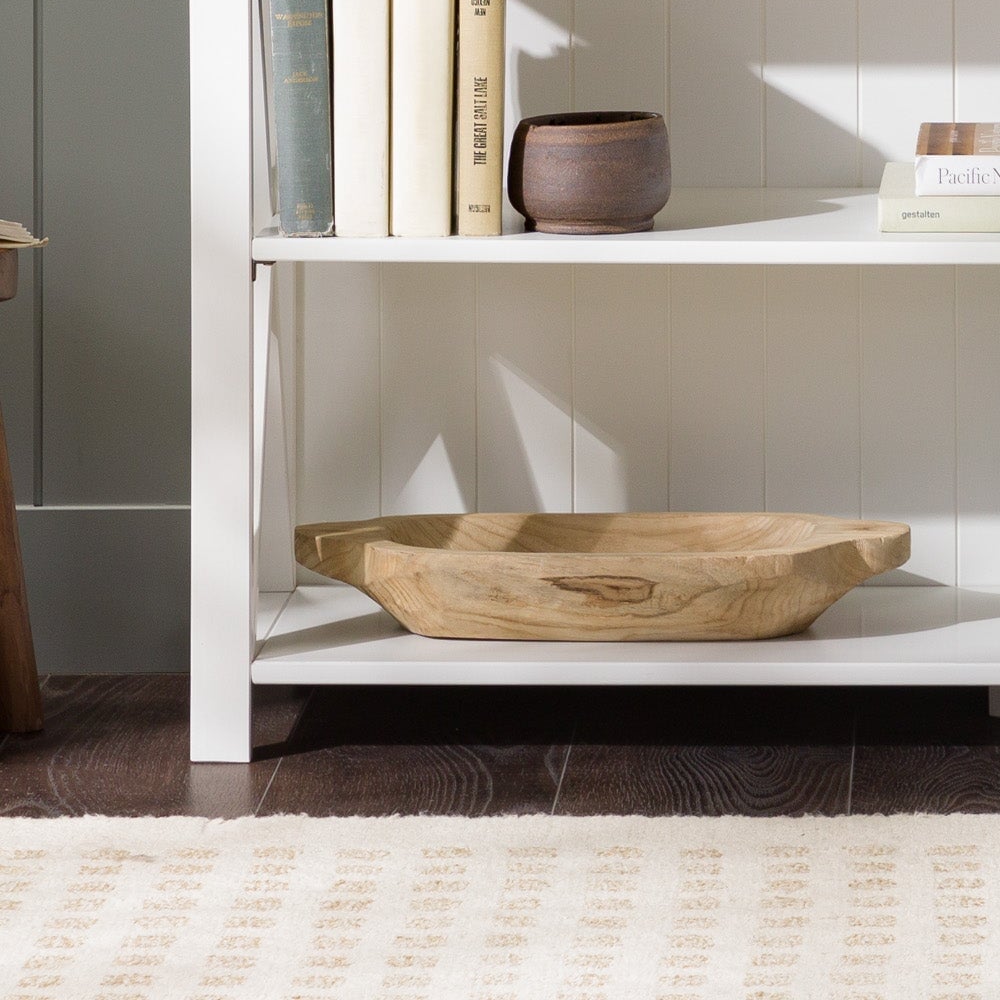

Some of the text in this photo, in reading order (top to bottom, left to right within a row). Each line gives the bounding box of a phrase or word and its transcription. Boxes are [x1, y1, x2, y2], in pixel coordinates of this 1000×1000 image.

[473, 76, 488, 165] THE GREAT SALT LAKE
[937, 166, 991, 185] Pacific
[901, 209, 941, 222] gestalten
